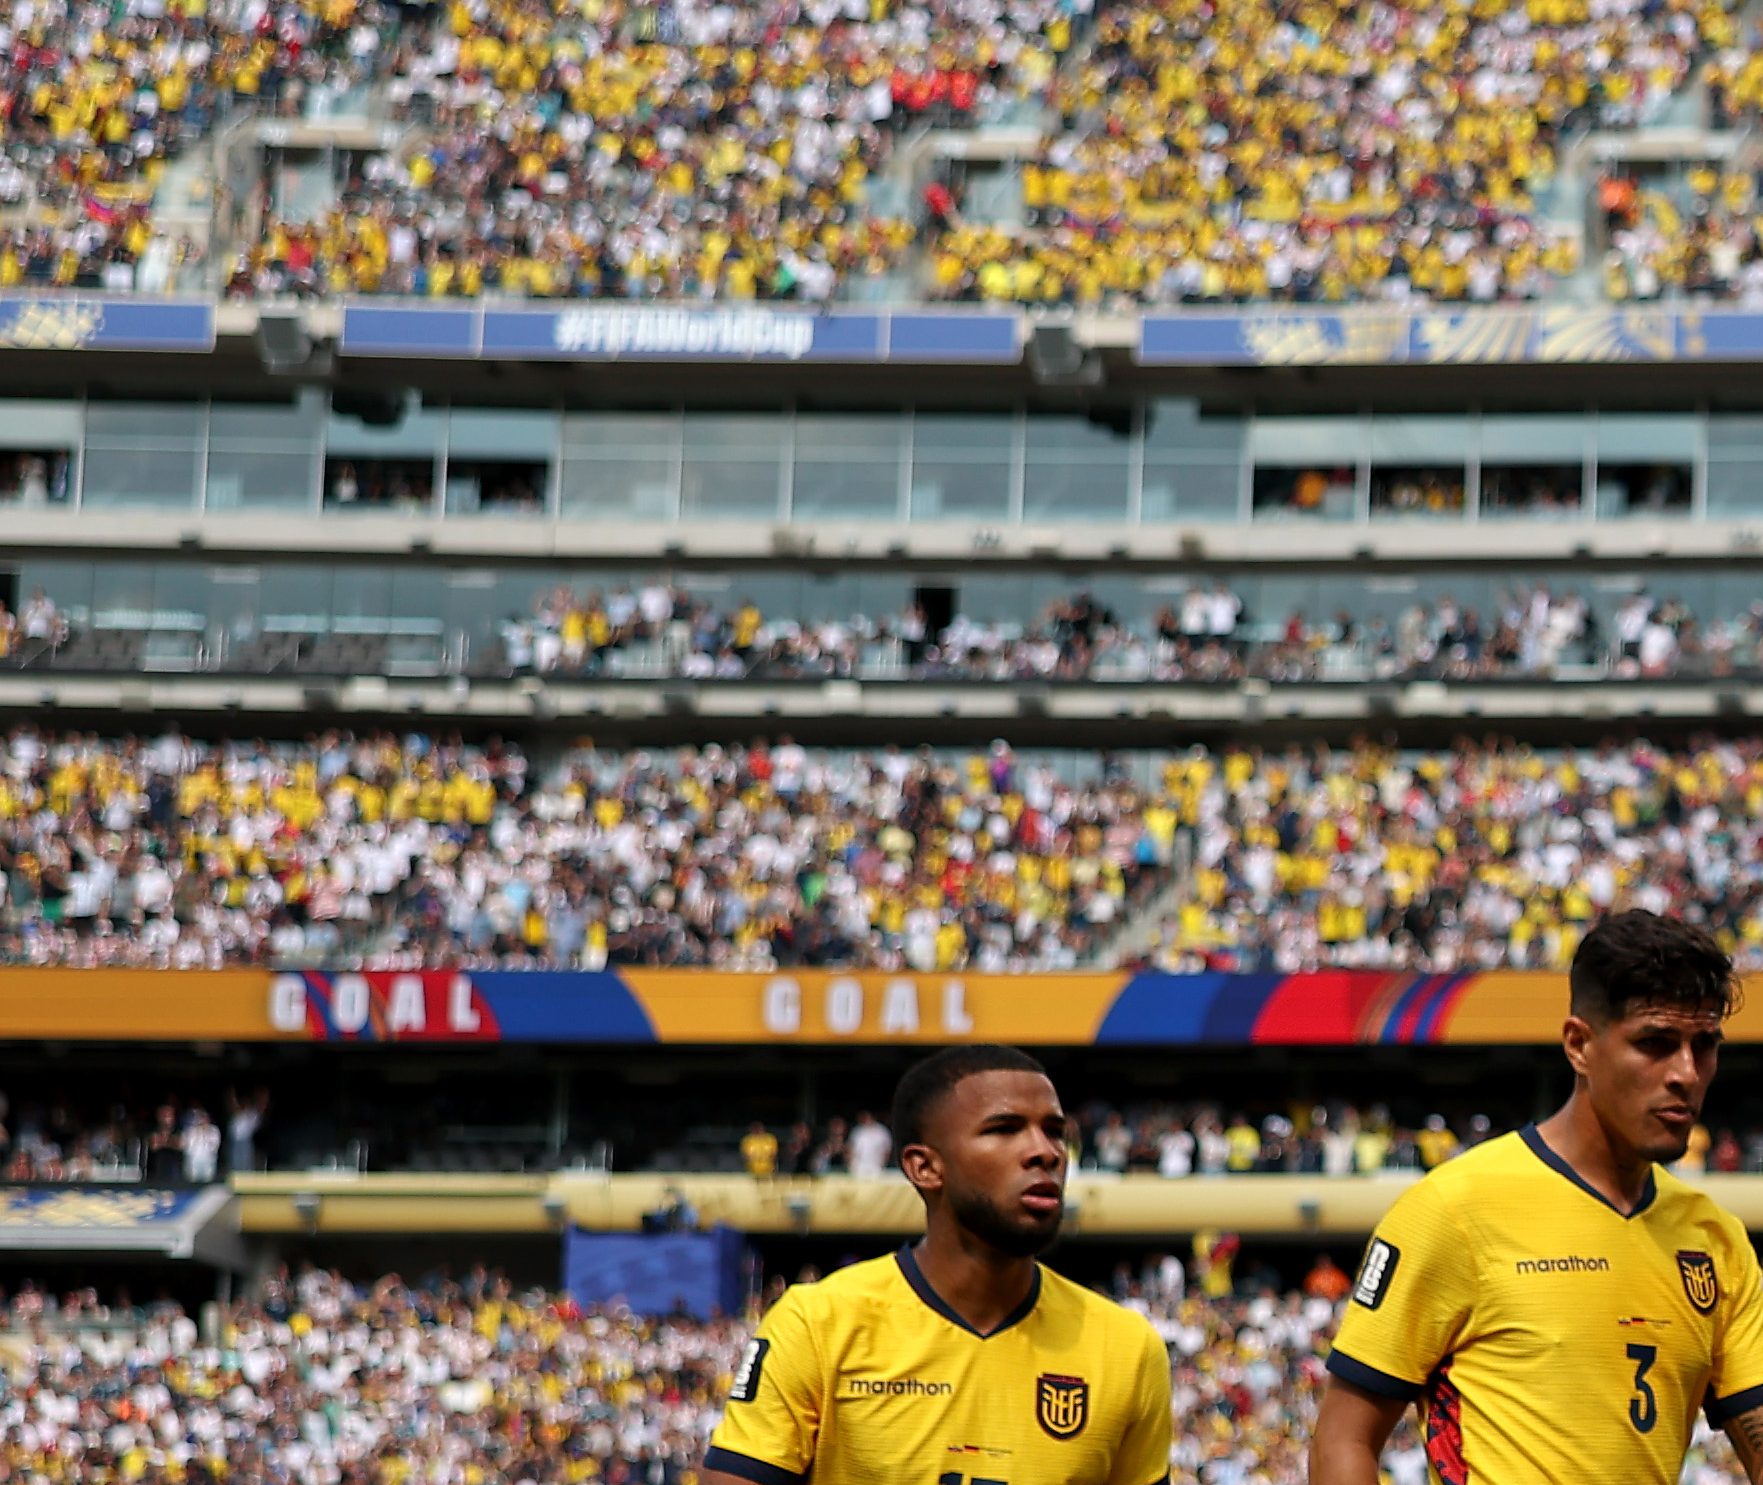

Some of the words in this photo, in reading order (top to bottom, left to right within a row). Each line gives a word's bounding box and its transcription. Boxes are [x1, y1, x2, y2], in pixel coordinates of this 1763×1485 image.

[268, 973, 481, 1033] GOAL
[761, 975, 974, 1035] GOAL
[1516, 1253, 1610, 1276] marathon
[849, 1376, 952, 1399] marathon
[1625, 1343, 1657, 1434] 3
